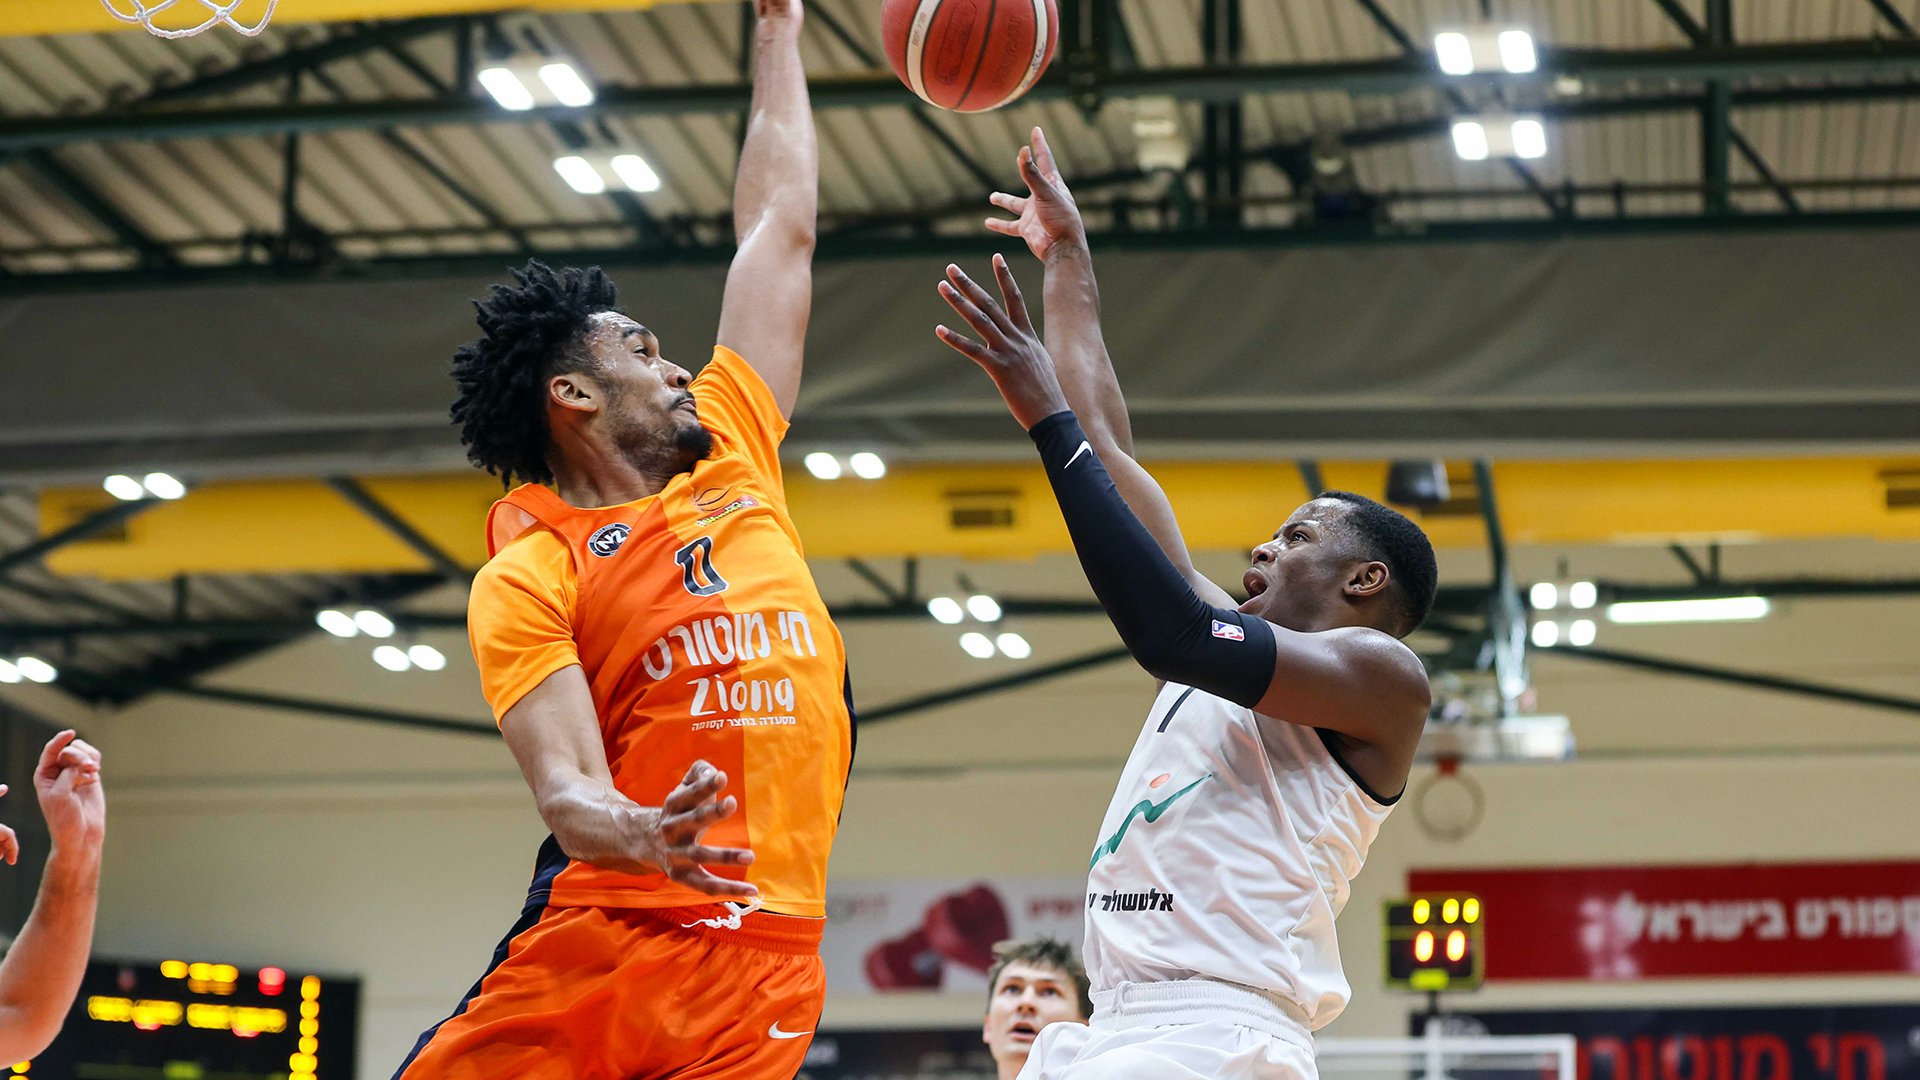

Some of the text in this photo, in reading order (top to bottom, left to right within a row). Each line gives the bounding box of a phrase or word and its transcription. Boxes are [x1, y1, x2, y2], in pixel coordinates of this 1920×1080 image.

[674, 535, 729, 597] 0
[641, 611, 817, 681] חי מוטורס
[686, 674, 795, 717] Ziona
[691, 716, 796, 732] מסעדה בחצר קסומה
[1101, 887, 1174, 912] אלטשולר
[1616, 892, 1789, 942] בישראל
